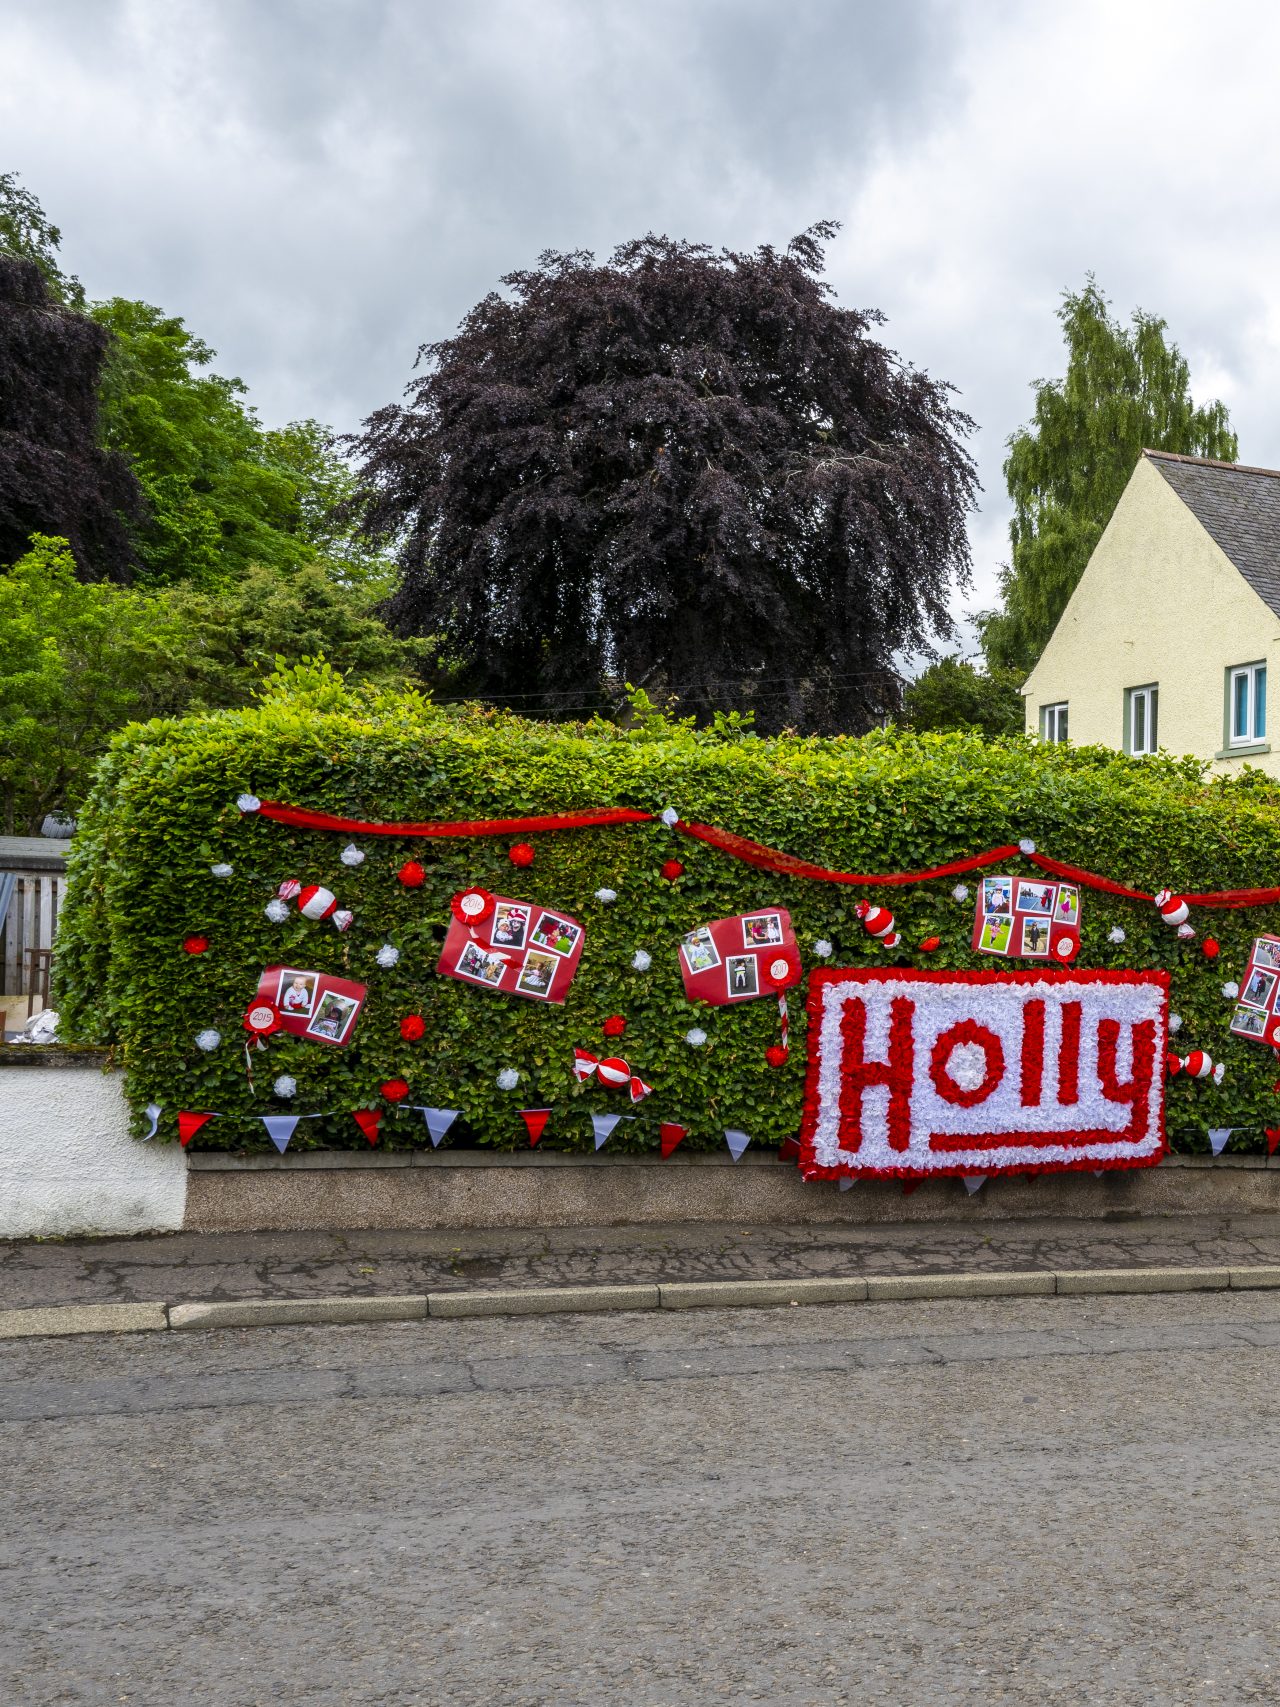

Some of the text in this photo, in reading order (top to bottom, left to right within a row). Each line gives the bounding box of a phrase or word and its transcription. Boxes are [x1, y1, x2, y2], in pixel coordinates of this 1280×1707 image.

[463, 896, 483, 910] 2016
[773, 962, 787, 976] 2017
[253, 1011, 272, 1022] 2015
[838, 996, 1156, 1152] Holly
